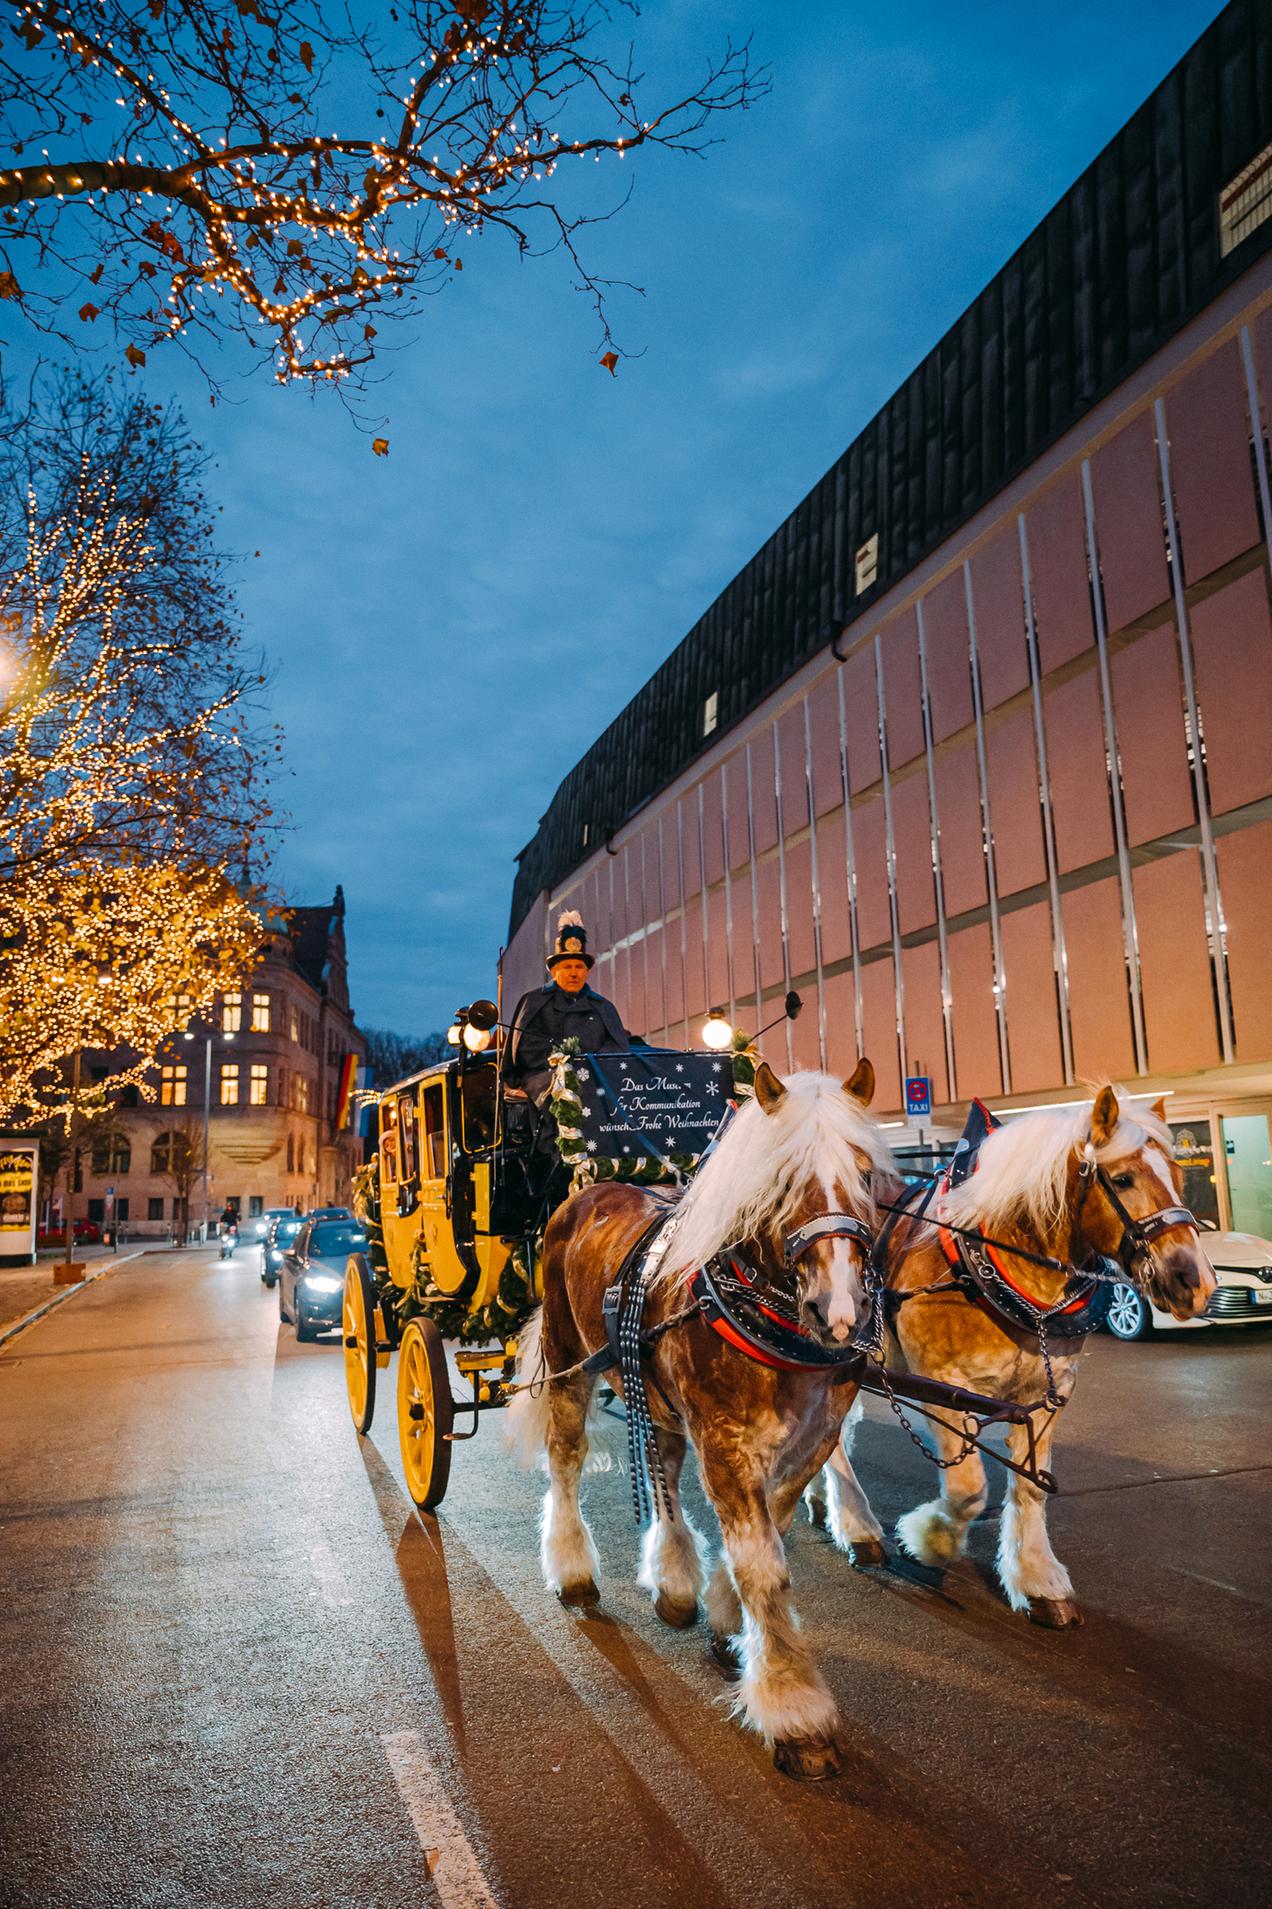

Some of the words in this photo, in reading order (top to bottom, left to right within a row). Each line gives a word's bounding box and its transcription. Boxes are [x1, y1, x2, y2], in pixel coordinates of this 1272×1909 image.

[620, 1077, 644, 1092] Das
[629, 1093, 701, 1111] Kommunikation
[909, 1103, 928, 1112] TAXI
[599, 1115, 633, 1132] wünsch
[633, 1113, 662, 1131] Frohe
[664, 1111, 719, 1129] Weihnachten
